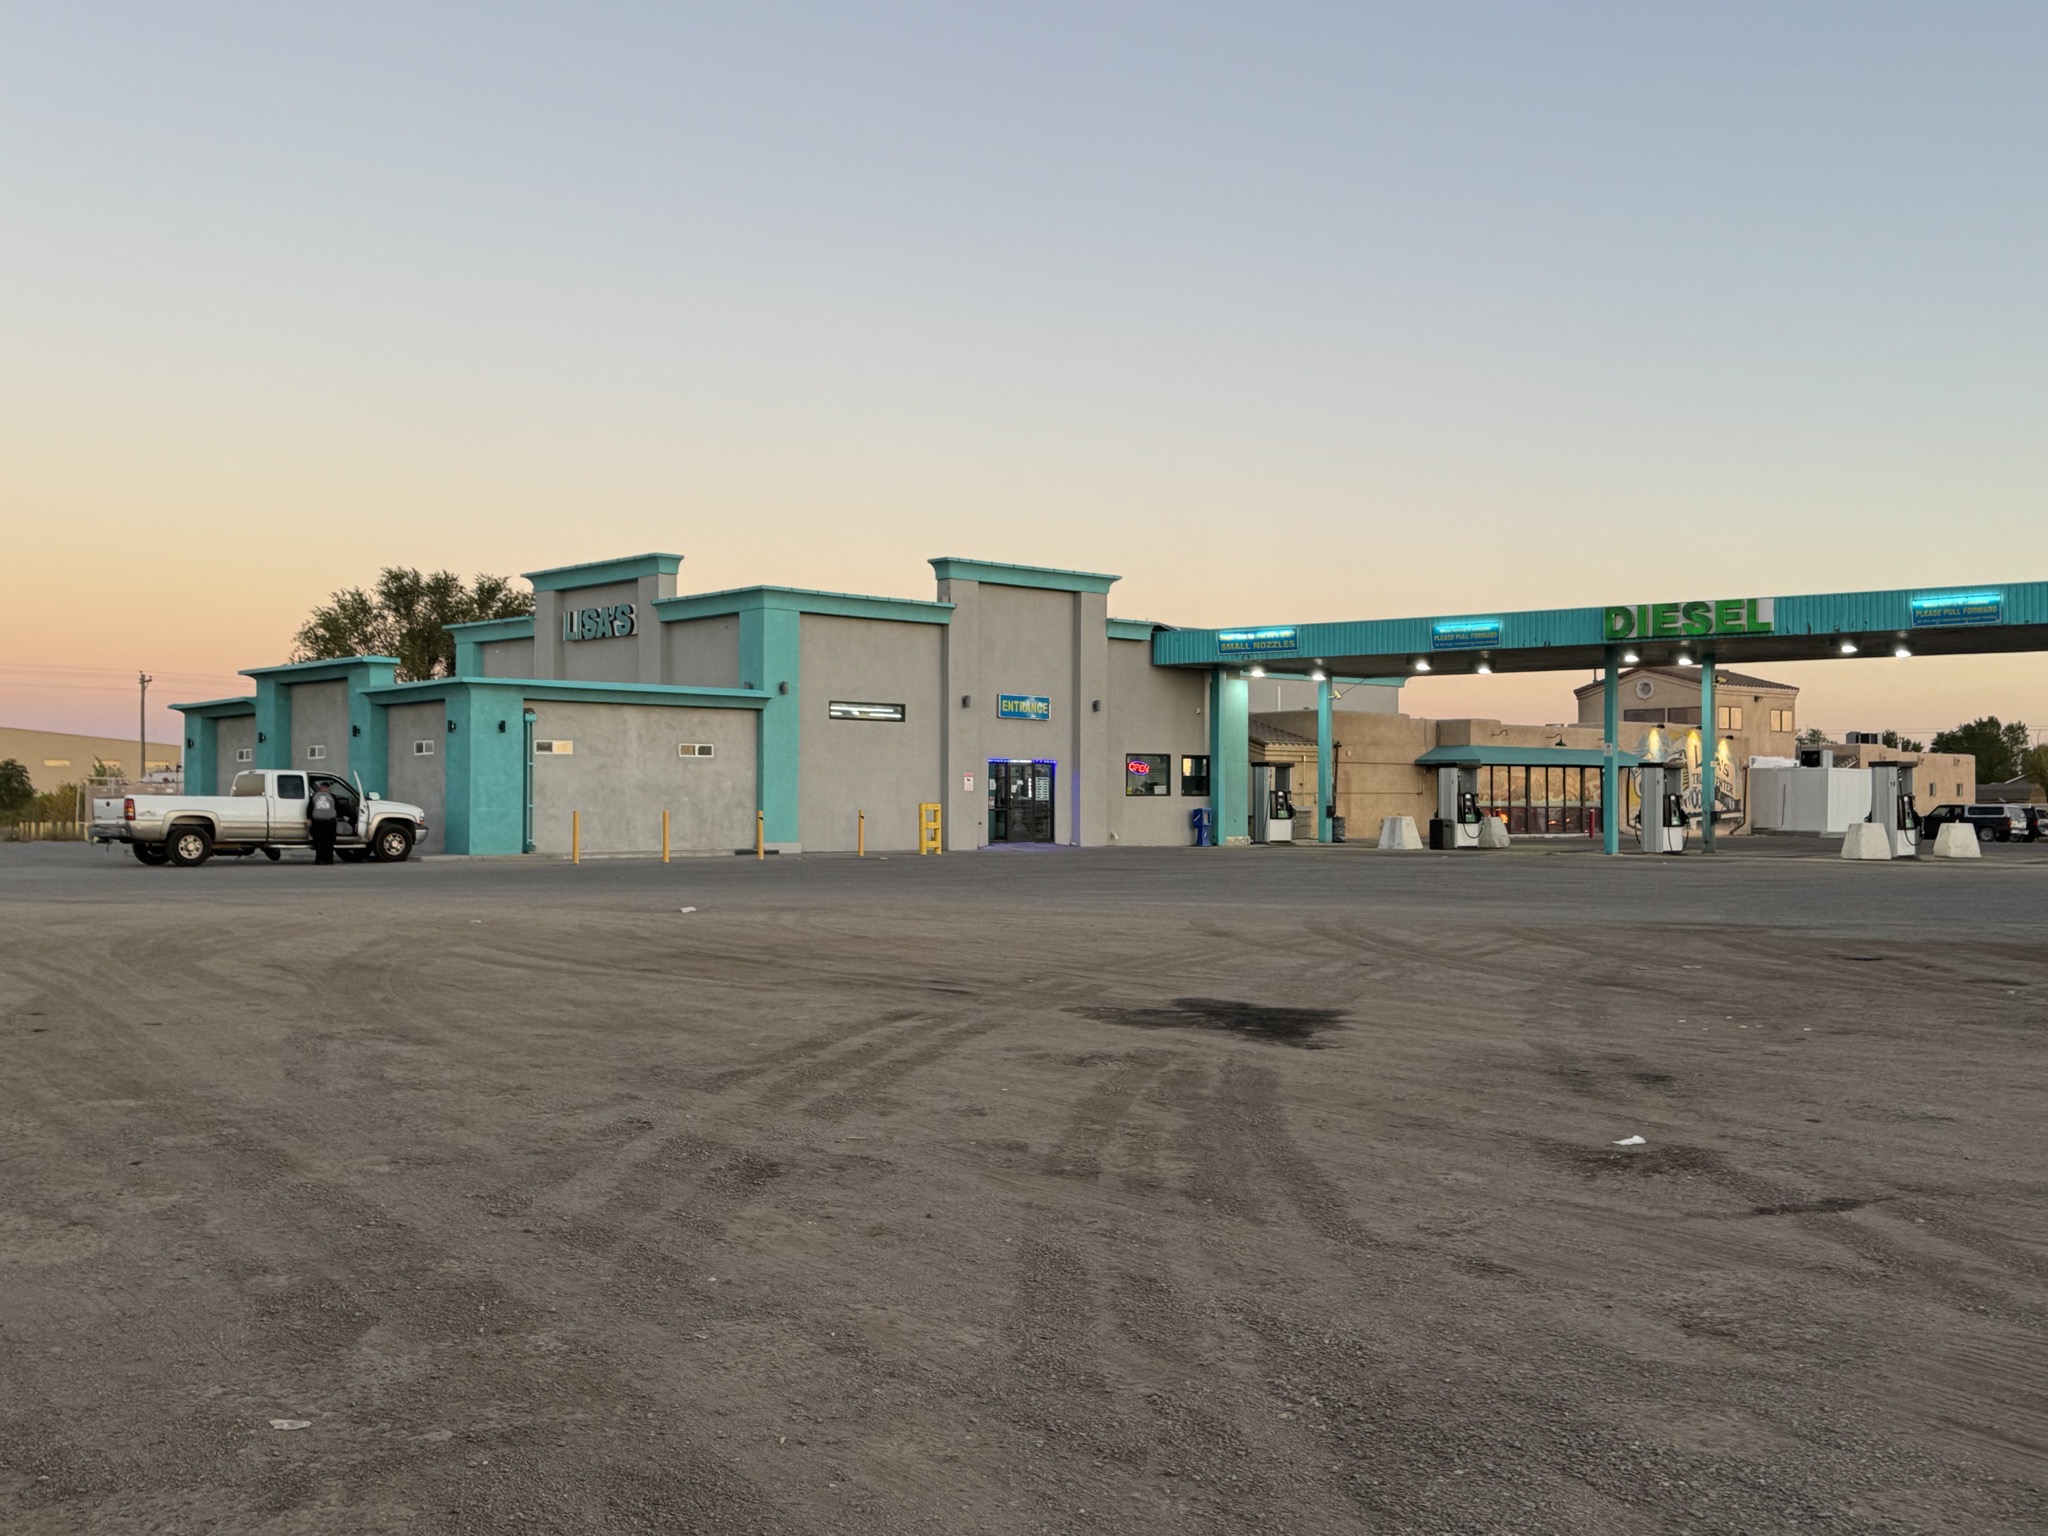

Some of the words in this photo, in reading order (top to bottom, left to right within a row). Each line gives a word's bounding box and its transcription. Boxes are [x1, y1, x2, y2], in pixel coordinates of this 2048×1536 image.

[1915, 609, 1941, 618] PLEASE
[1943, 608, 1961, 616] PULL
[1963, 605, 1998, 615] FORWARD
[563, 604, 635, 641] LISA'S
[1604, 598, 1773, 639] DIESEL
[1220, 642, 1251, 651] SMALL
[1253, 640, 1296, 649] NOZZLES
[1002, 700, 1049, 714] ENTRANCE
[1128, 762, 1150, 773] OPEN
